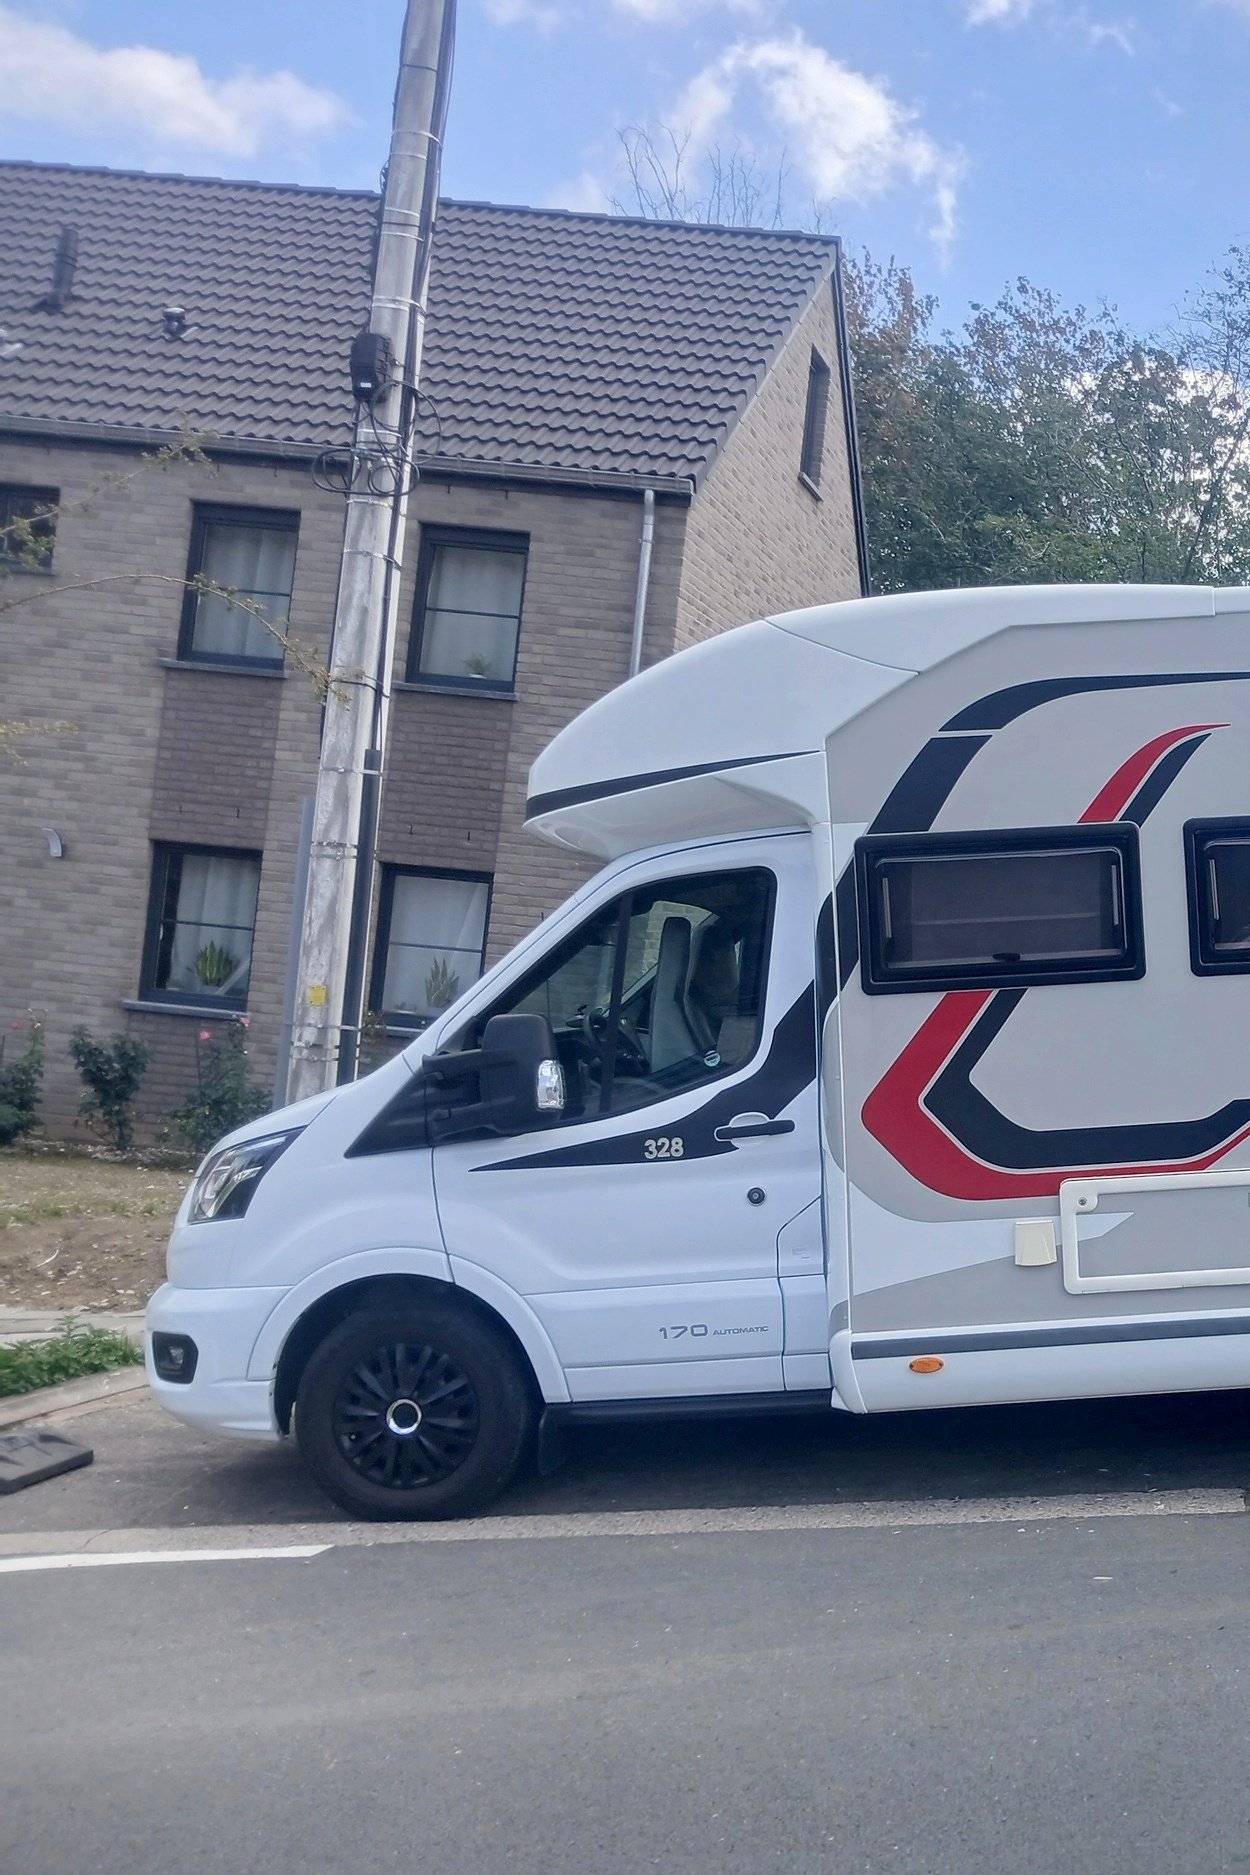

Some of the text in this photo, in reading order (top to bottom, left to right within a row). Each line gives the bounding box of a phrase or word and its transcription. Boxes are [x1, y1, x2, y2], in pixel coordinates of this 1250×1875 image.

[644, 1137, 684, 1159] 328
[659, 1324, 769, 1339] 170 AUTOMATIC
